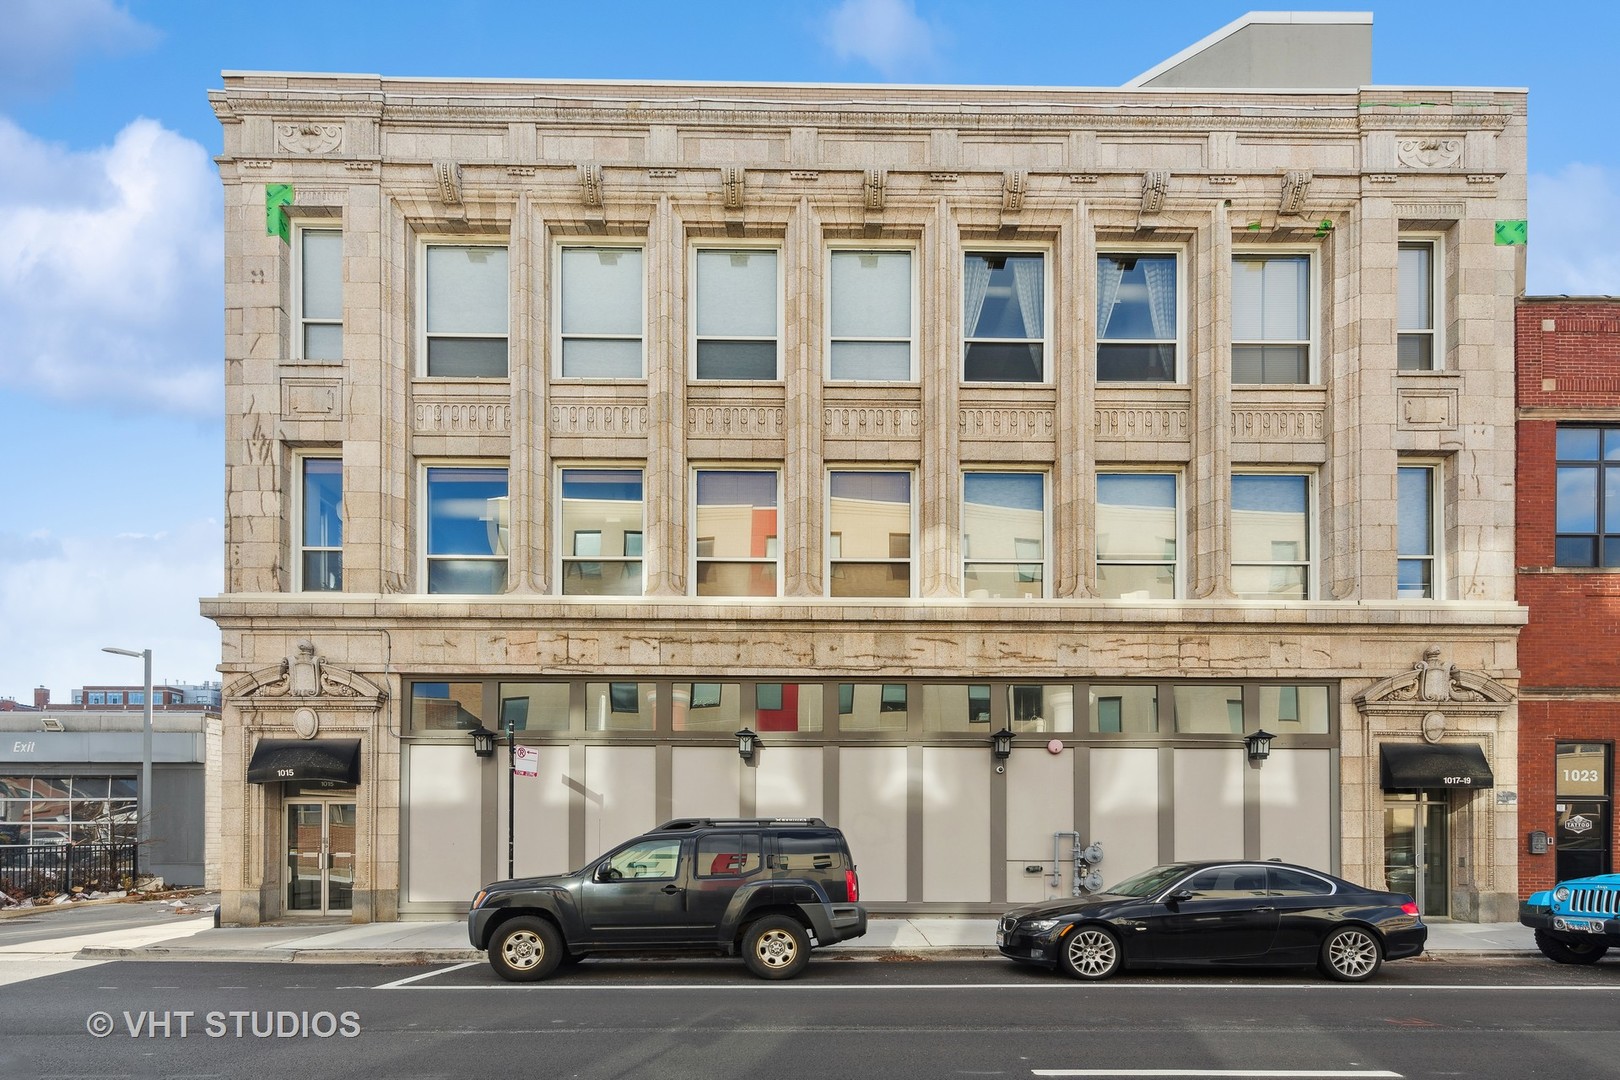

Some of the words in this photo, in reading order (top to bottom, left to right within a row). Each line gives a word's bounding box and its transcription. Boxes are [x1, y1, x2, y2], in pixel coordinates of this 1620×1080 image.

[13, 741, 36, 753] Exit
[277, 769, 295, 777] 1015
[1563, 769, 1599, 782] 1023
